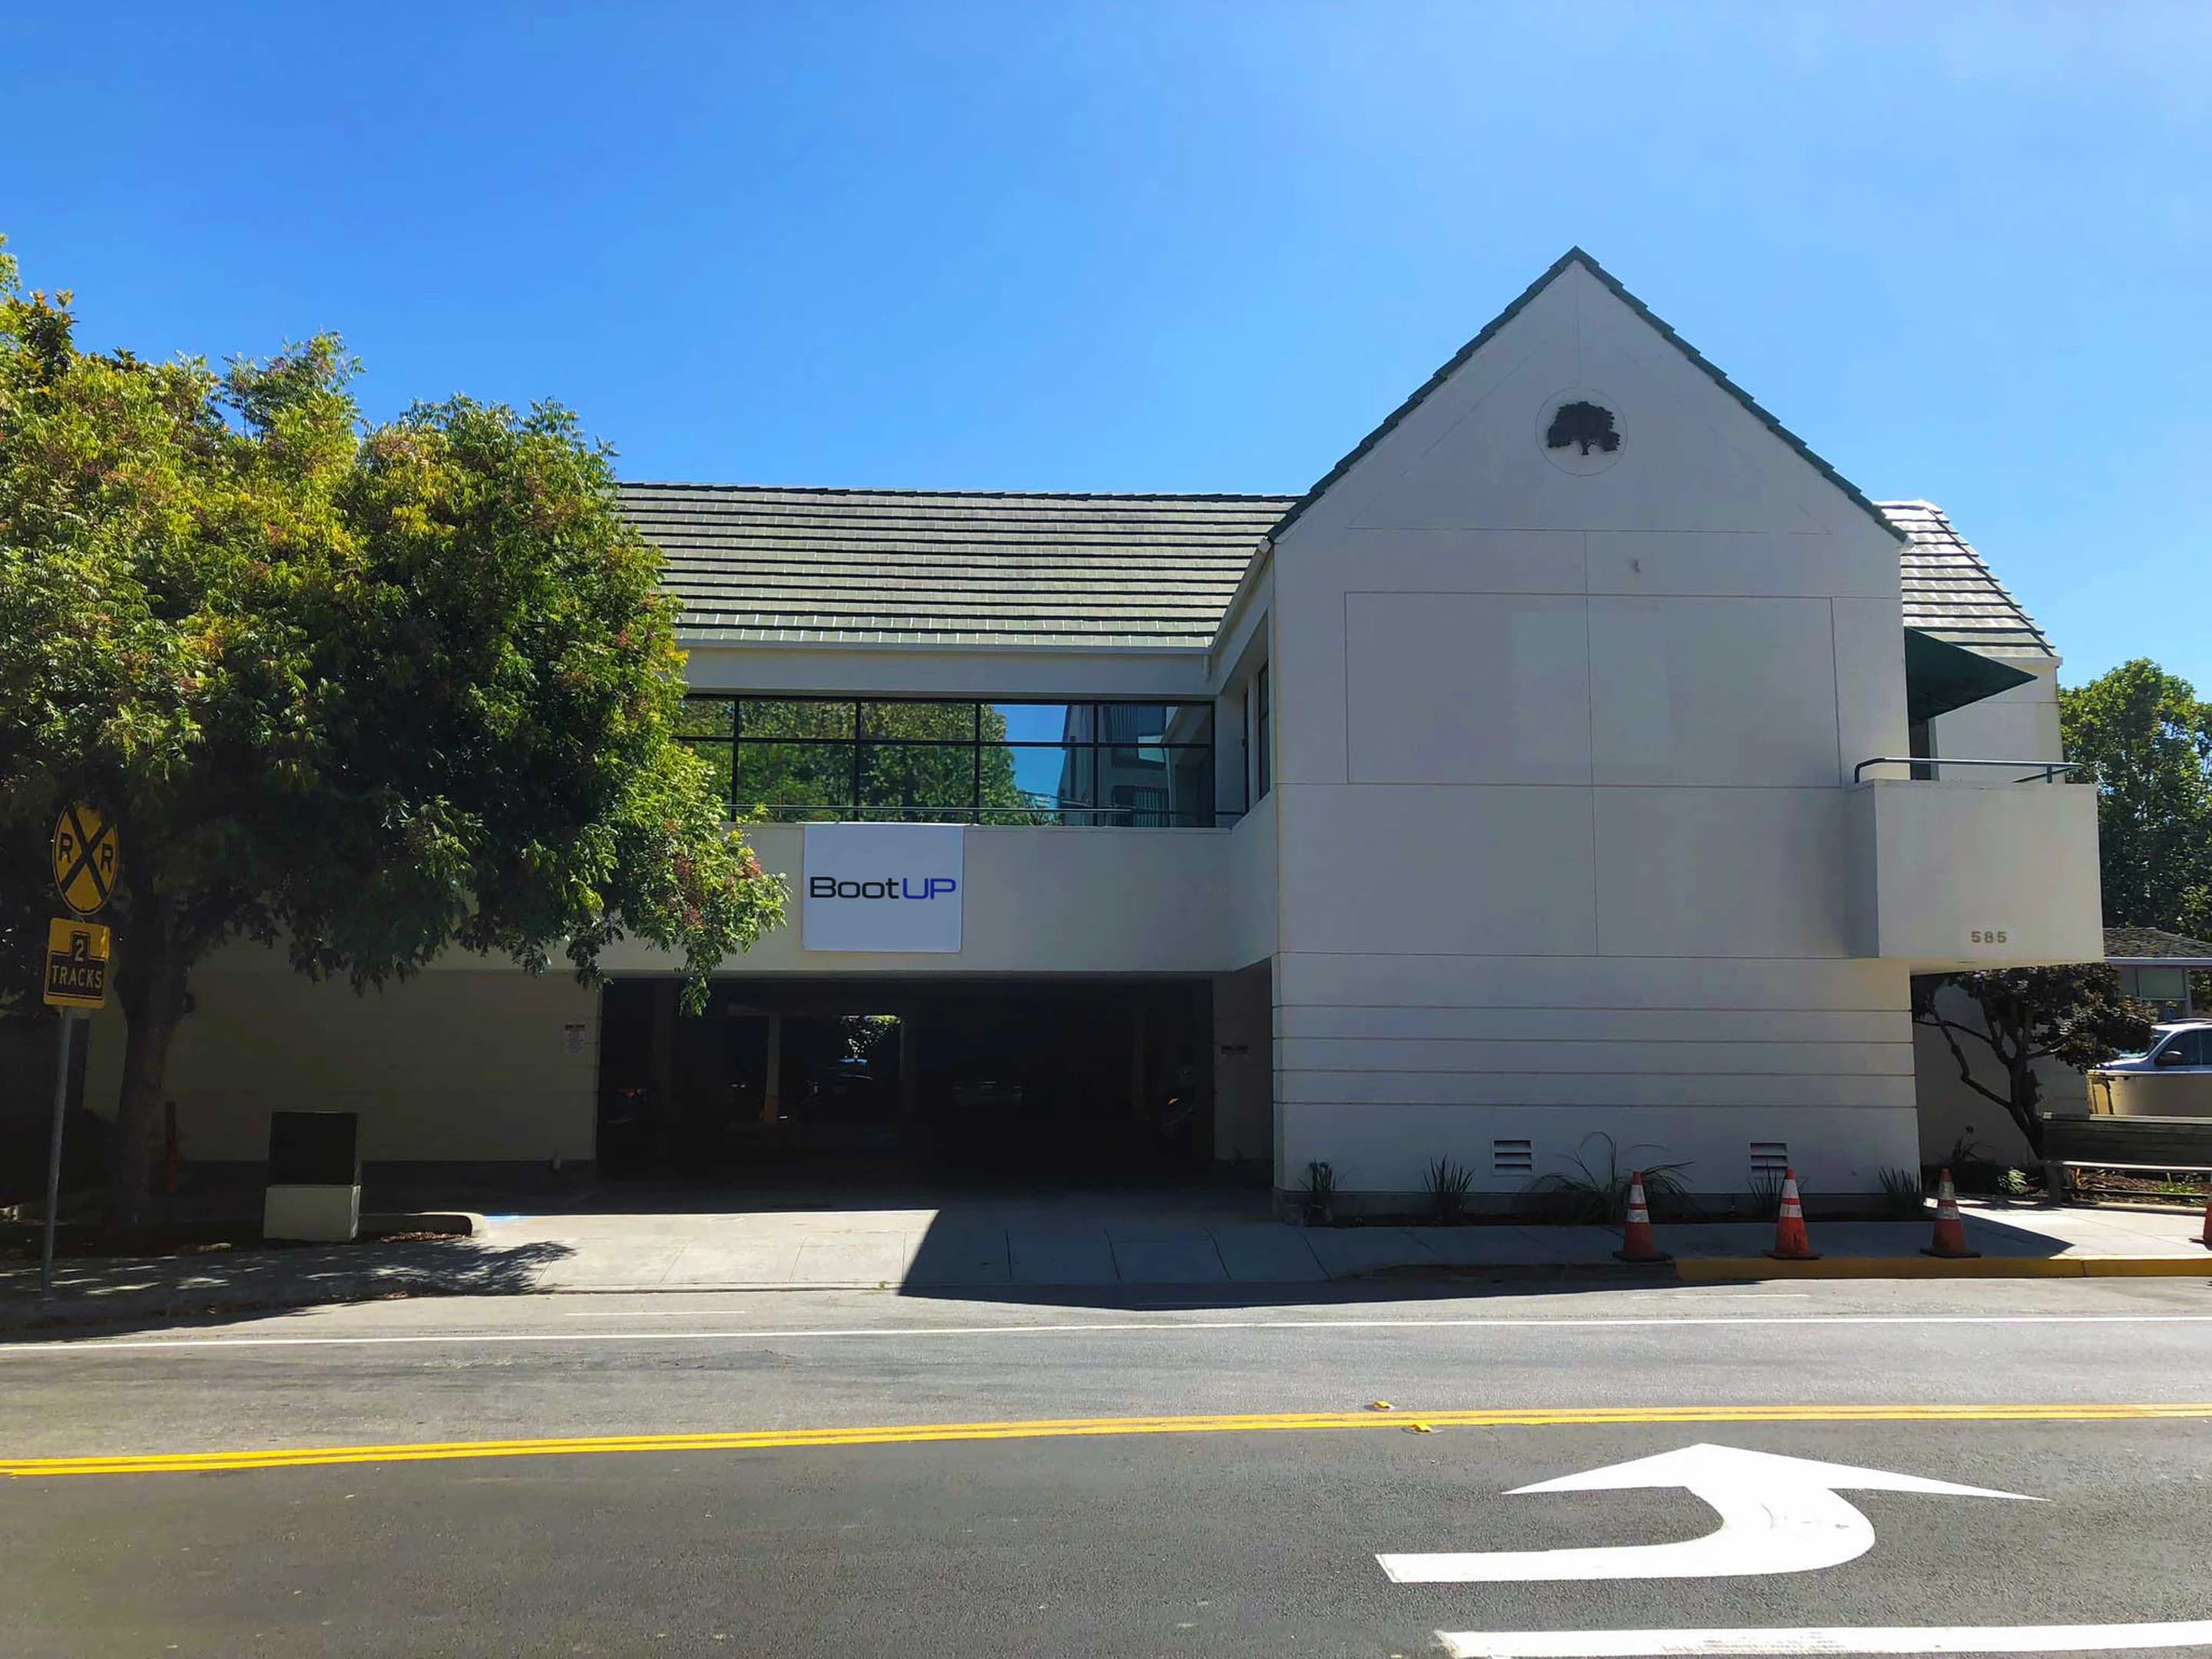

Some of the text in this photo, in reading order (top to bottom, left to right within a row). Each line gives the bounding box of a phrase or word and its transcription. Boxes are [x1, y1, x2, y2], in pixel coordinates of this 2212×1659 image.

[59, 833, 114, 873] R R
[810, 876, 957, 900] BootUP
[1971, 931, 2008, 944] 585
[74, 939, 84, 962] 2
[51, 964, 103, 989] TRACKS
